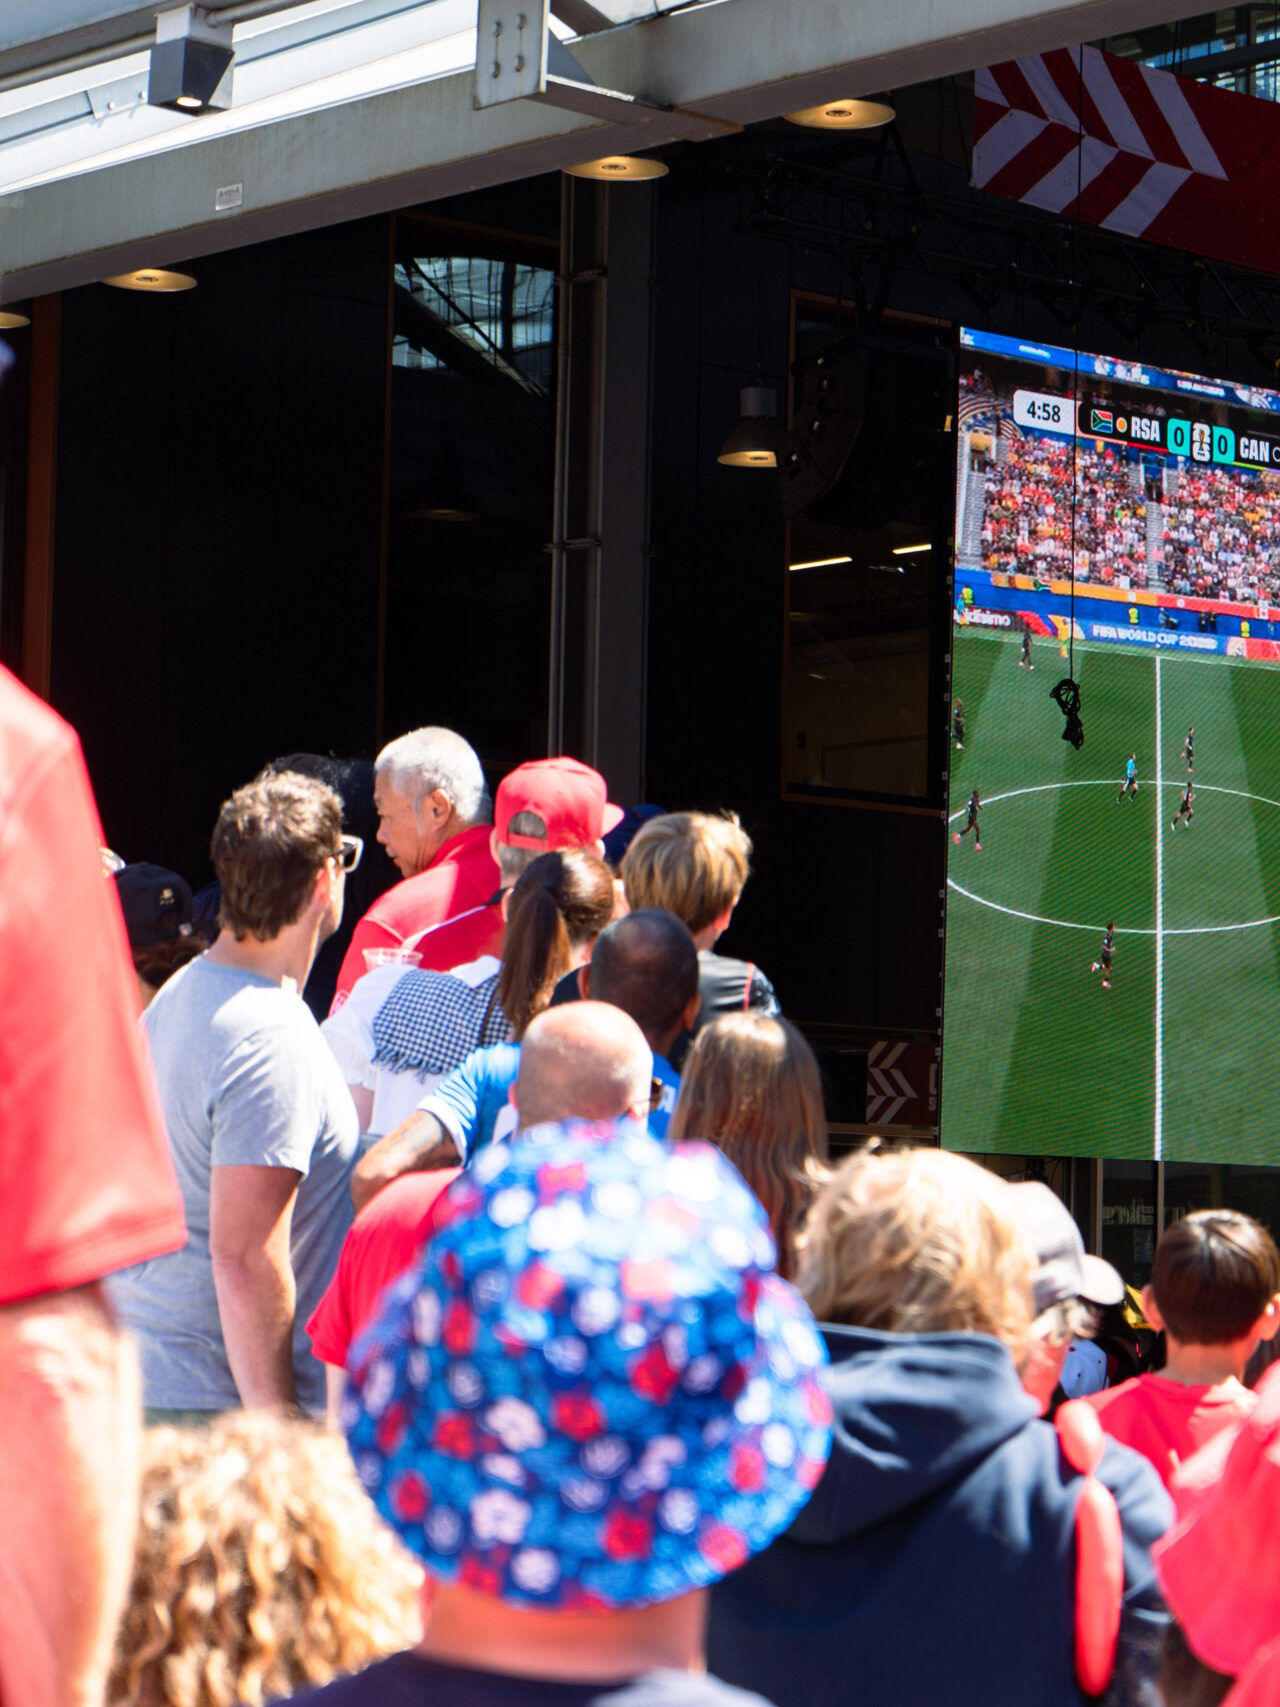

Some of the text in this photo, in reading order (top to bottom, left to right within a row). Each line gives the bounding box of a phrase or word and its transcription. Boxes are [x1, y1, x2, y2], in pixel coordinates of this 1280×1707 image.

[1026, 400, 1061, 423] 4:58
[1131, 416, 1161, 442] RSA
[1173, 426, 1185, 448] 0
[1217, 434, 1229, 456] 0
[1240, 437, 1271, 463] CAN
[1093, 624, 1117, 638] FIFA
[1117, 627, 1157, 643] WORLD
[1157, 632, 1179, 645] CUP
